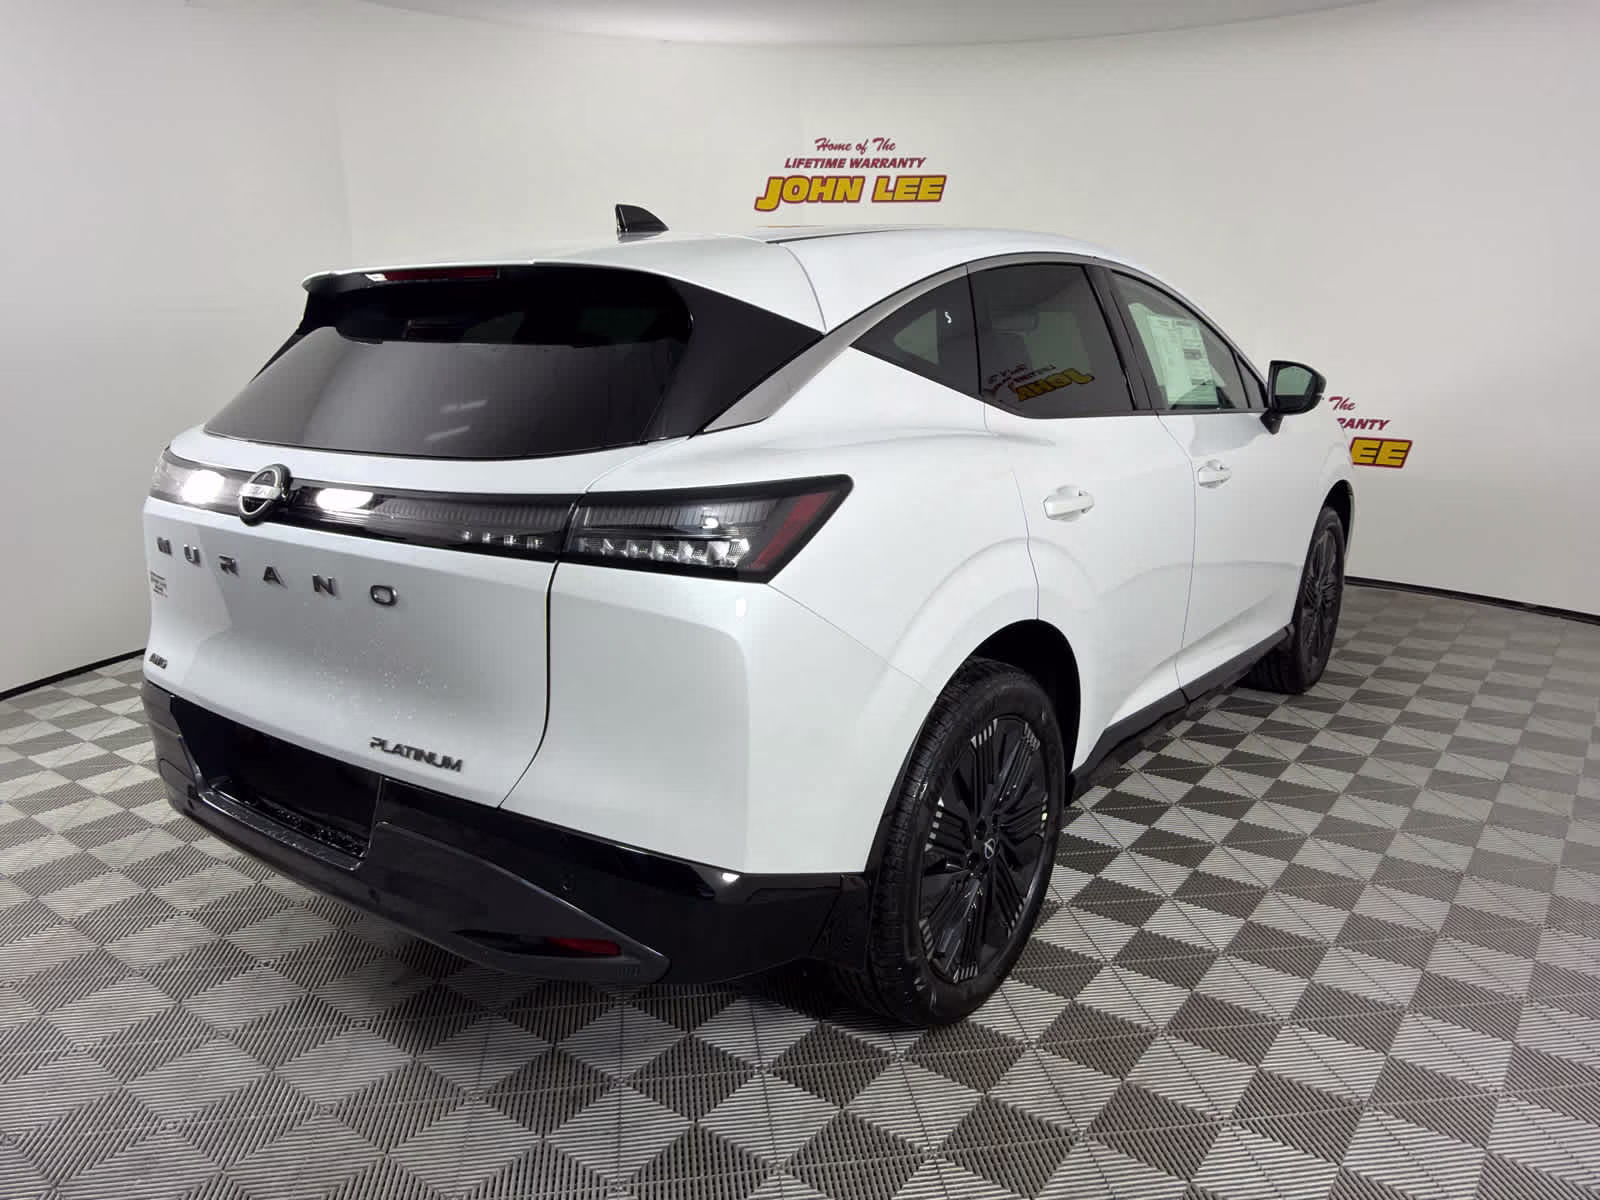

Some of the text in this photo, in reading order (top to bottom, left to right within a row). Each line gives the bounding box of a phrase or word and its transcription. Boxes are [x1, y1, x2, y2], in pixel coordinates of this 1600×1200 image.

[814, 137, 896, 155] Home of The
[784, 157, 927, 169] LIFETIME WARRANTY
[754, 175, 947, 212] JOHN LEE
[1328, 395, 1356, 411] The
[370, 736, 463, 773] PLATINUM
